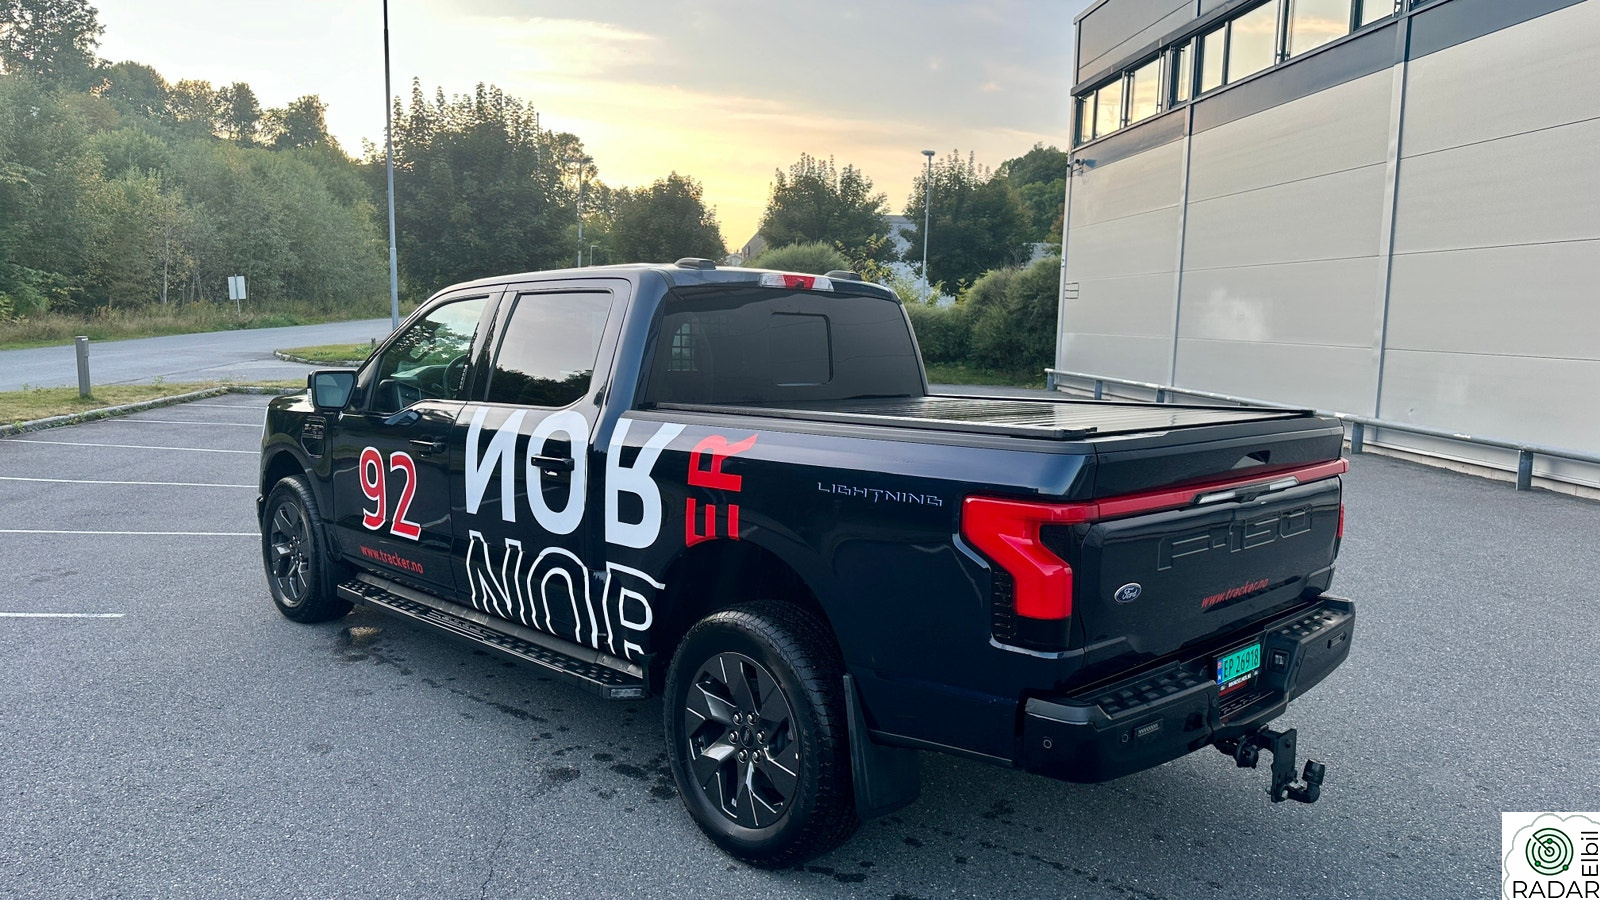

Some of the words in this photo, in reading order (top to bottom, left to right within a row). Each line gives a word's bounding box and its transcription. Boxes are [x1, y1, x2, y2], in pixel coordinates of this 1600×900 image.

[359, 446, 421, 541] 92
[818, 481, 942, 506] LIGHTNING
[1157, 503, 1313, 571] F-150
[360, 545, 424, 574] www.tracker.no
[1201, 577, 1269, 608] www.tracker.no
[1224, 658, 1234, 678] EP
[1235, 648, 1259, 673] 26918
